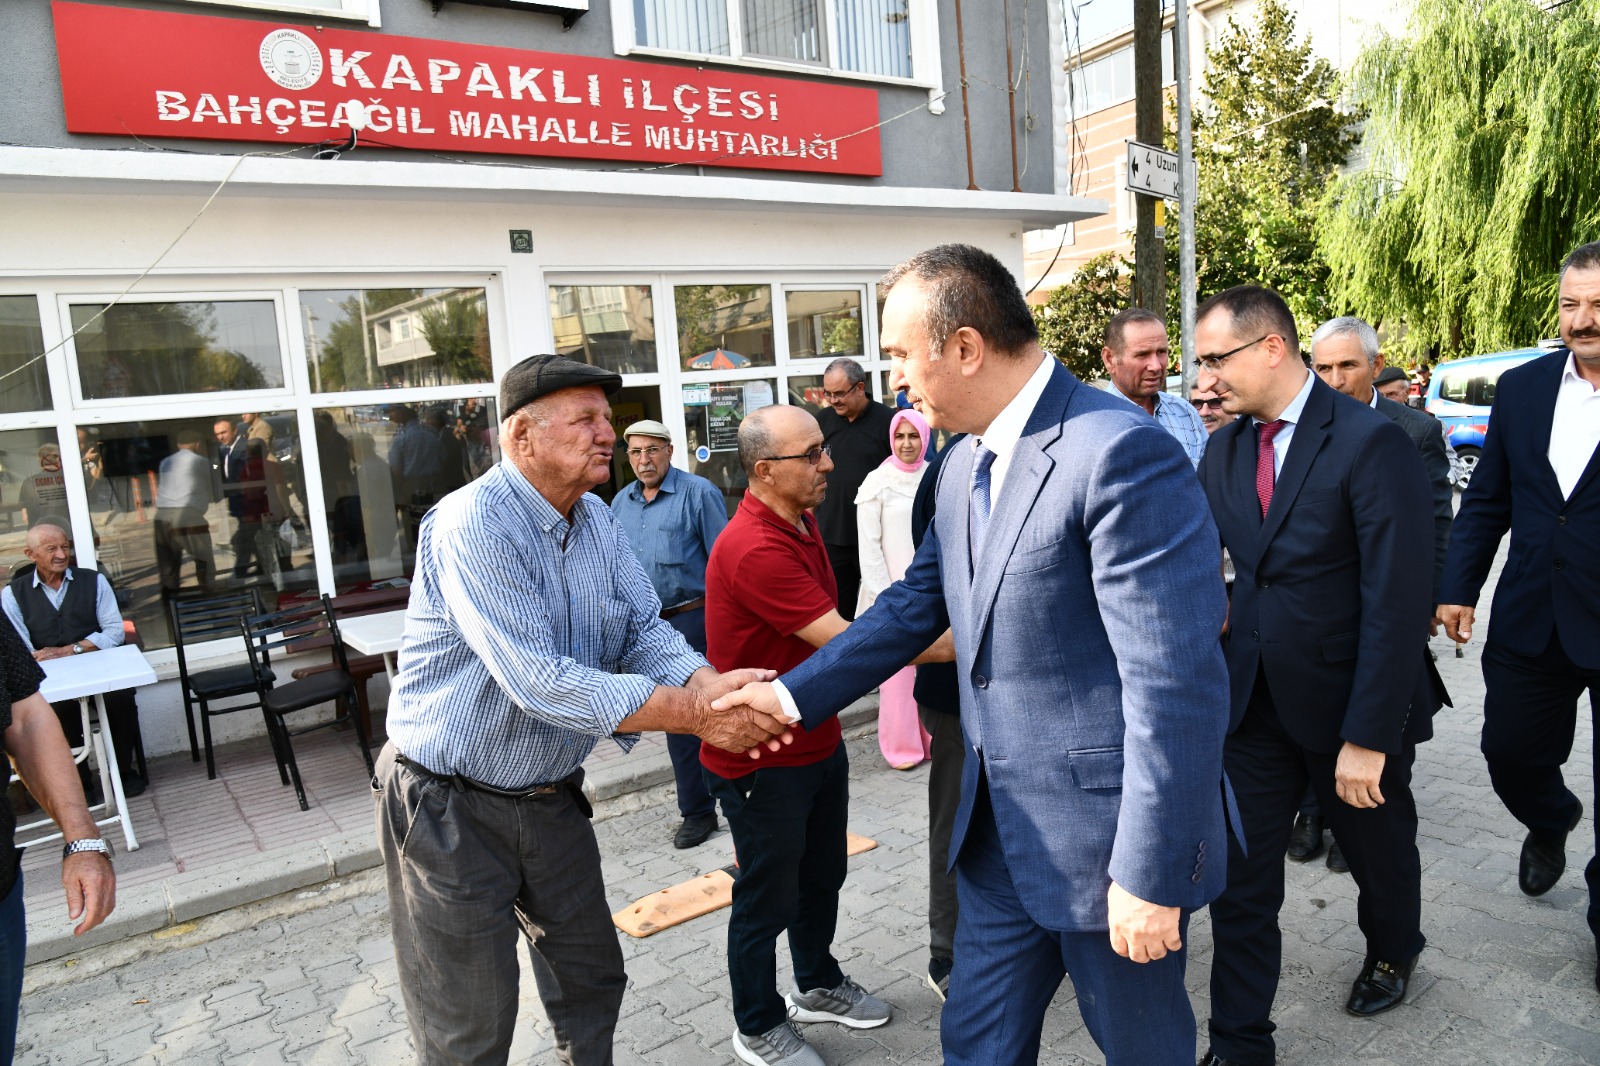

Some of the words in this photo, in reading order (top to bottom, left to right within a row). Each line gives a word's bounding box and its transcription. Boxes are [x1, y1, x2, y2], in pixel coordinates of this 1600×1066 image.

[329, 48, 602, 107] KAPAKLI
[622, 78, 779, 123] İLÇESİ
[156, 90, 436, 135] BAHÇEAĞIL
[449, 110, 633, 147] MAHALLE
[645, 124, 838, 161] MUHTARLIĞI
[1145, 152, 1151, 165] 4
[1156, 154, 1178, 174] Uzun
[1145, 174, 1151, 188] 4
